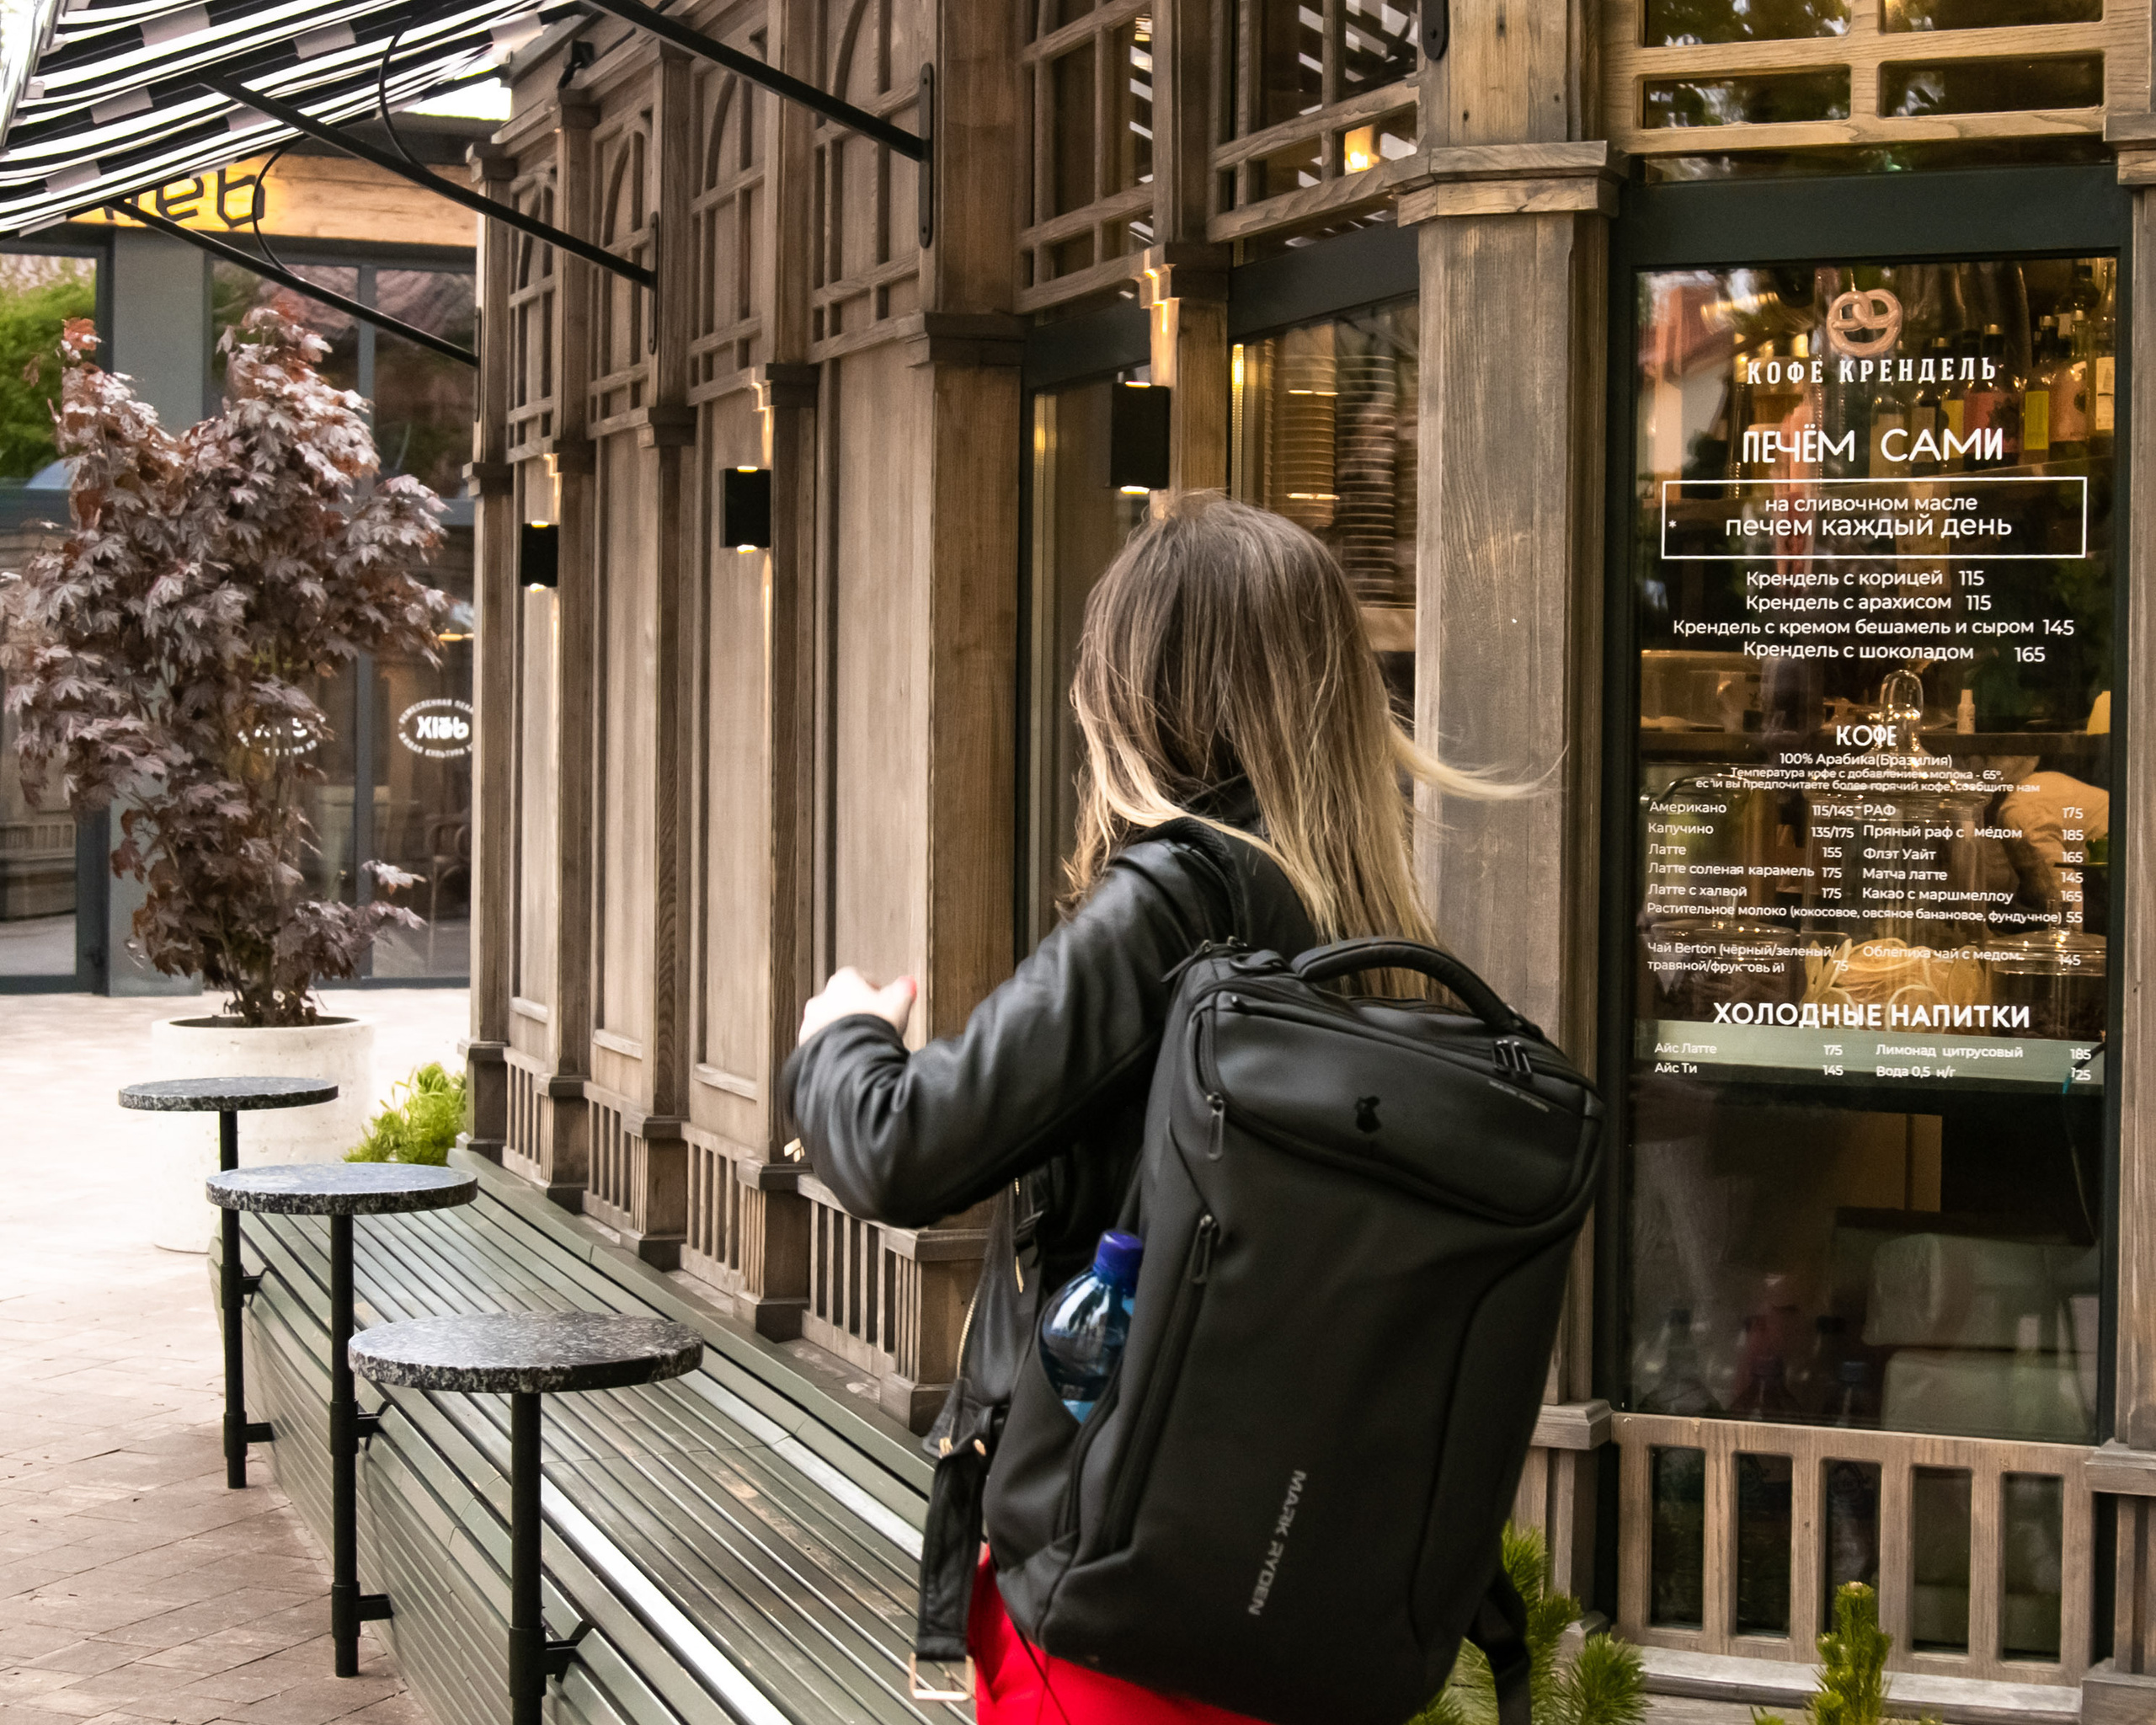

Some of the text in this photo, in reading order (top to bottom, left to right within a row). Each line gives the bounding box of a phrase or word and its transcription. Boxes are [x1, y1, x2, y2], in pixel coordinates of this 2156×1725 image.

[1747, 357, 1996, 385] КОФЕ КРЕНДЕЛЬ
[1743, 424, 2004, 463] ПЕЧЁМ САМИ
[1765, 495, 1978, 512] на сливочном масле
[1726, 513, 2013, 539] печем каждый день
[1746, 569, 1985, 590] Крендель с корицей 115
[1746, 595, 1992, 613] Крендель с арахисом 115
[1673, 619, 2074, 638] Крендель с кремом бешамель и сыром 145
[1743, 642, 2046, 663] Крендель с шоколадом 165
[1836, 724, 1897, 746] КОФЕ
[1780, 753, 1813, 765] 100%
[1730, 767, 1805, 780] Температура
[1807, 768, 1836, 780] кофе
[1930, 771, 1973, 779] молока
[1726, 780, 1741, 788] вы
[1832, 779, 1867, 790] более
[1870, 781, 1919, 793] горячий
[2016, 784, 2041, 793] нам
[1649, 801, 1727, 815] Американо
[1812, 804, 1854, 817] 115/145
[1863, 804, 1897, 816] РАФ
[2062, 807, 2084, 820] 175
[1648, 822, 1715, 836] Капучино
[1811, 826, 1854, 839] 135/175
[1863, 824, 1922, 839] Пряный
[1924, 825, 1954, 841] раф
[1956, 828, 1965, 838] с
[2062, 829, 2084, 841] 185
[1648, 843, 1687, 856] Латте
[1822, 846, 1843, 858] 155
[1863, 847, 1937, 861] Флэт Уайт
[2062, 852, 2084, 863] 165
[1648, 862, 1815, 878] Латте соленая карамель
[1822, 867, 1843, 879] 175
[1862, 868, 1948, 881] Матча латте
[2061, 872, 2084, 884] 145
[1648, 884, 1748, 897] Латте с халвой
[1822, 888, 1843, 899] 175
[1862, 888, 2015, 905] Какао с маршмеллоу
[2061, 890, 2083, 902] 165
[1647, 902, 1735, 916] Растительное
[1737, 905, 1787, 916] молоко
[1862, 909, 1914, 920] овсяное
[2066, 911, 2083, 923] 55
[1648, 943, 1672, 953] Чай
[1675, 943, 1716, 954] Berton
[1863, 946, 1931, 959] Облепиха
[1935, 948, 1959, 959] чай
[1961, 950, 1970, 959] с
[1713, 1002, 2031, 1028] ХОЛОДНЫЕ НАПИТКИ
[1654, 1043, 1717, 1055] Айс Латте
[1823, 1044, 1843, 1056] 175
[1876, 1044, 2024, 1060] Лимонад цитрусовый
[2069, 1048, 2092, 1060] 185
[1654, 1062, 1698, 1074] Айс Ти
[1822, 1065, 1844, 1076] 145
[1876, 1065, 1909, 1078] Вода
[1912, 1065, 1931, 1079] 0,5
